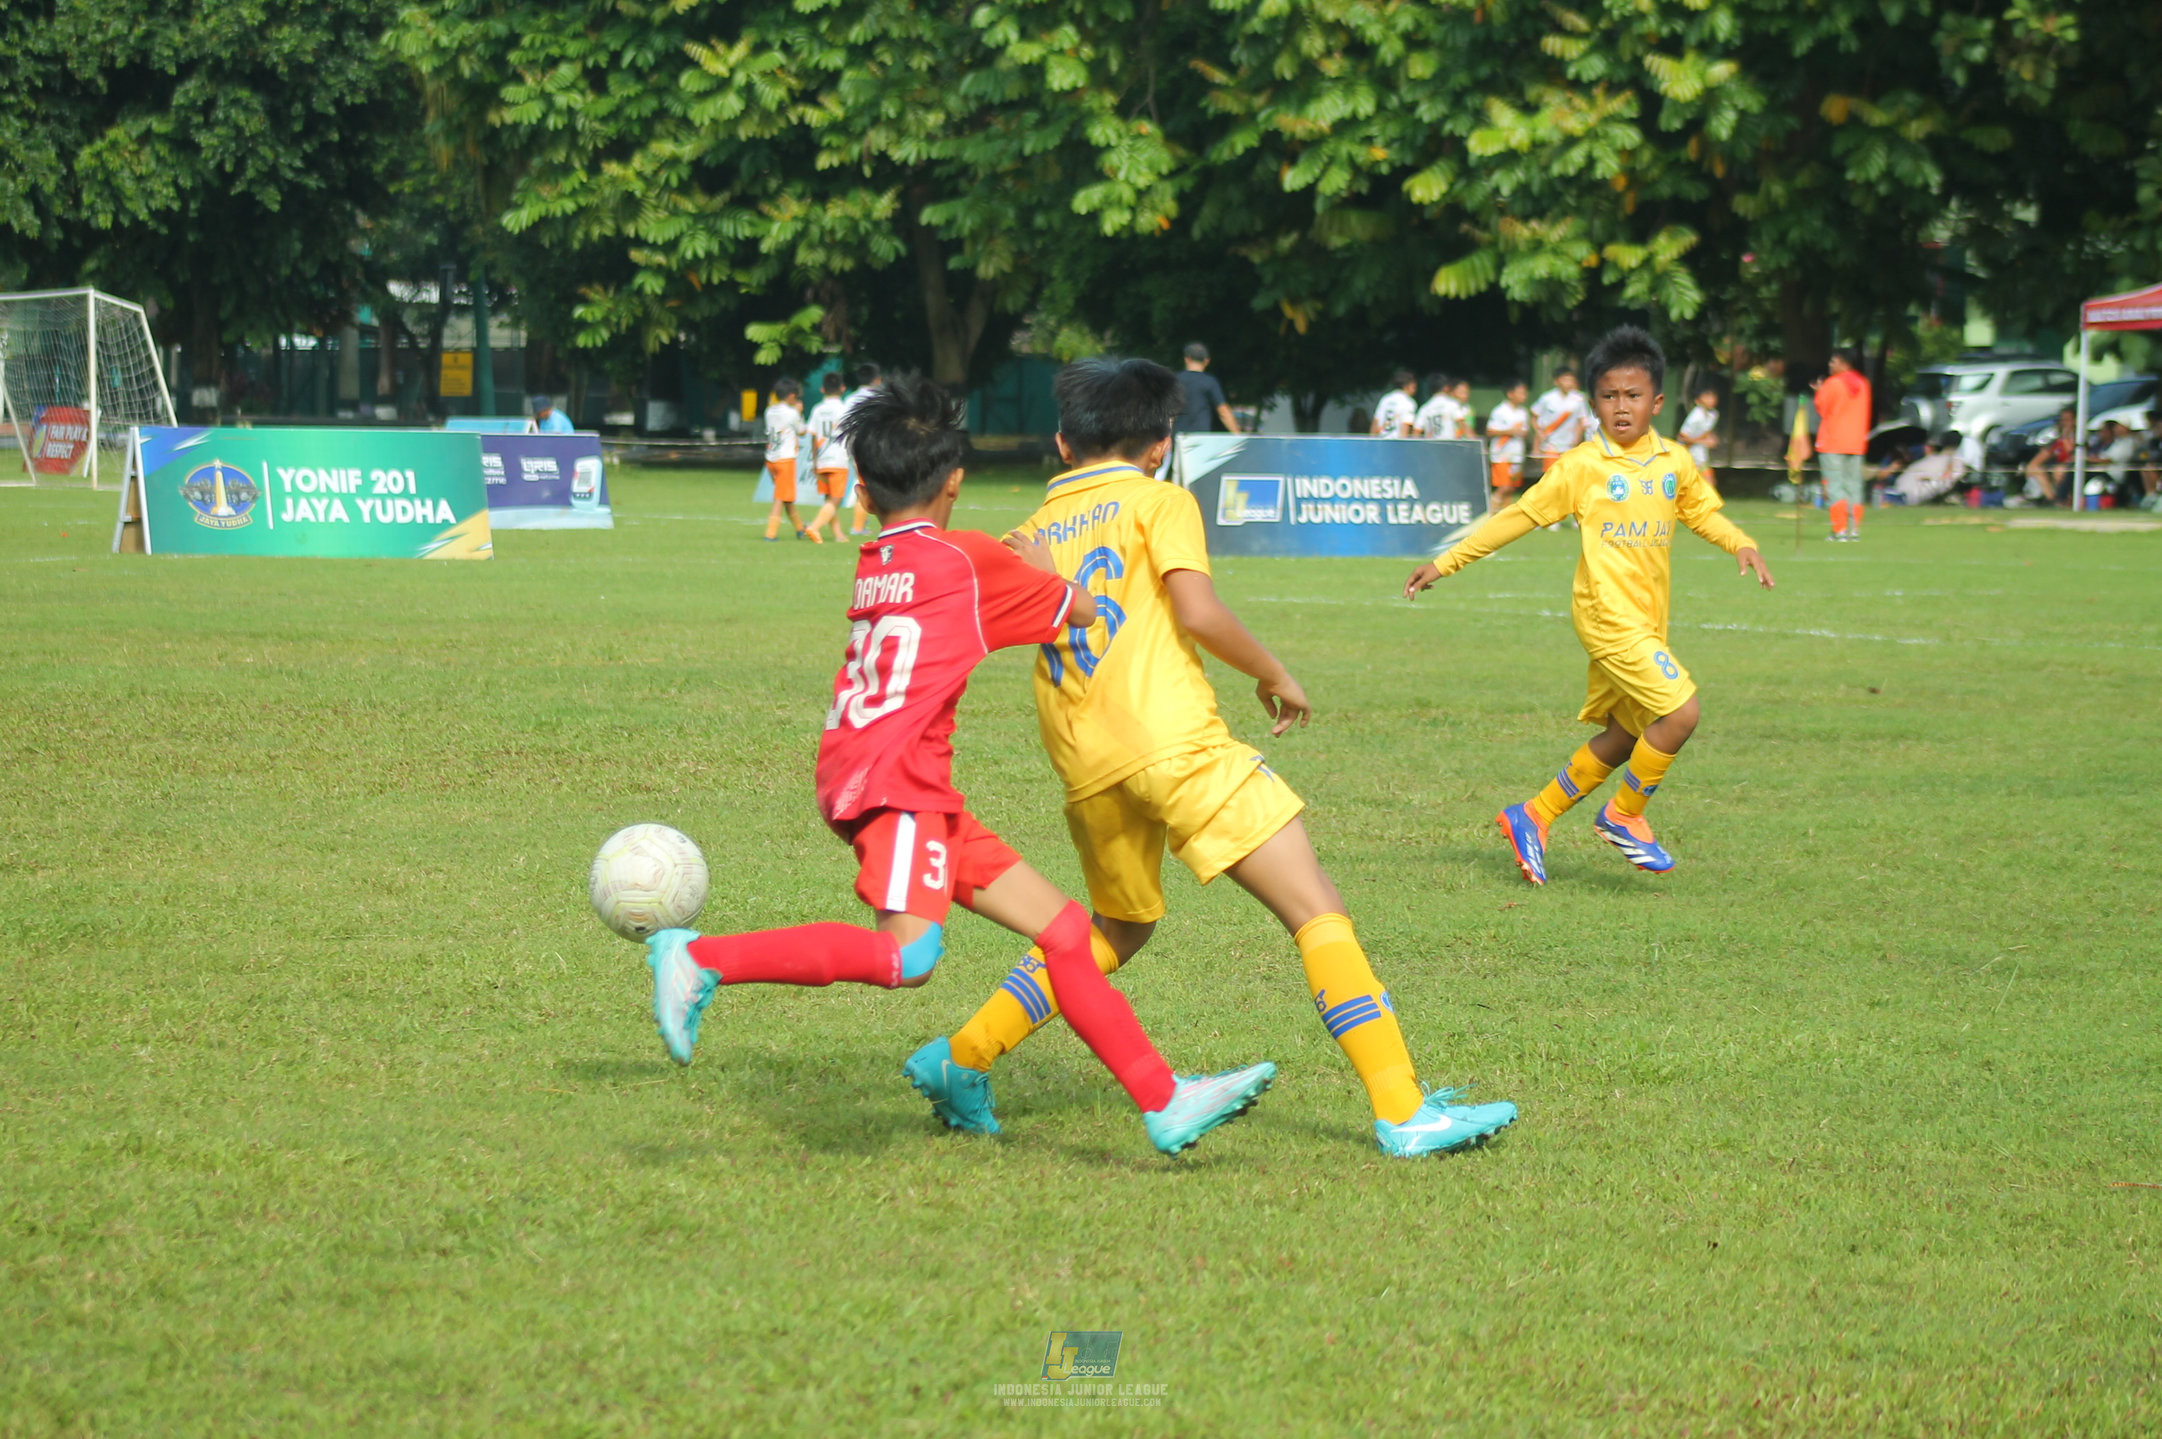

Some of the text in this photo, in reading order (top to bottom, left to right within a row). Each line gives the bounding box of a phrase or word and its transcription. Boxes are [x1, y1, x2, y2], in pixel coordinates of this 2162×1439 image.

[276, 467, 417, 495] YONIF 201
[1294, 476, 1419, 500] INDONESIA
[281, 497, 457, 524] JAYA YUDHA
[1297, 501, 1472, 525] JUNIOR LEAGUE
[1600, 521, 1648, 538] PAM
[1654, 651, 1679, 680] 8
